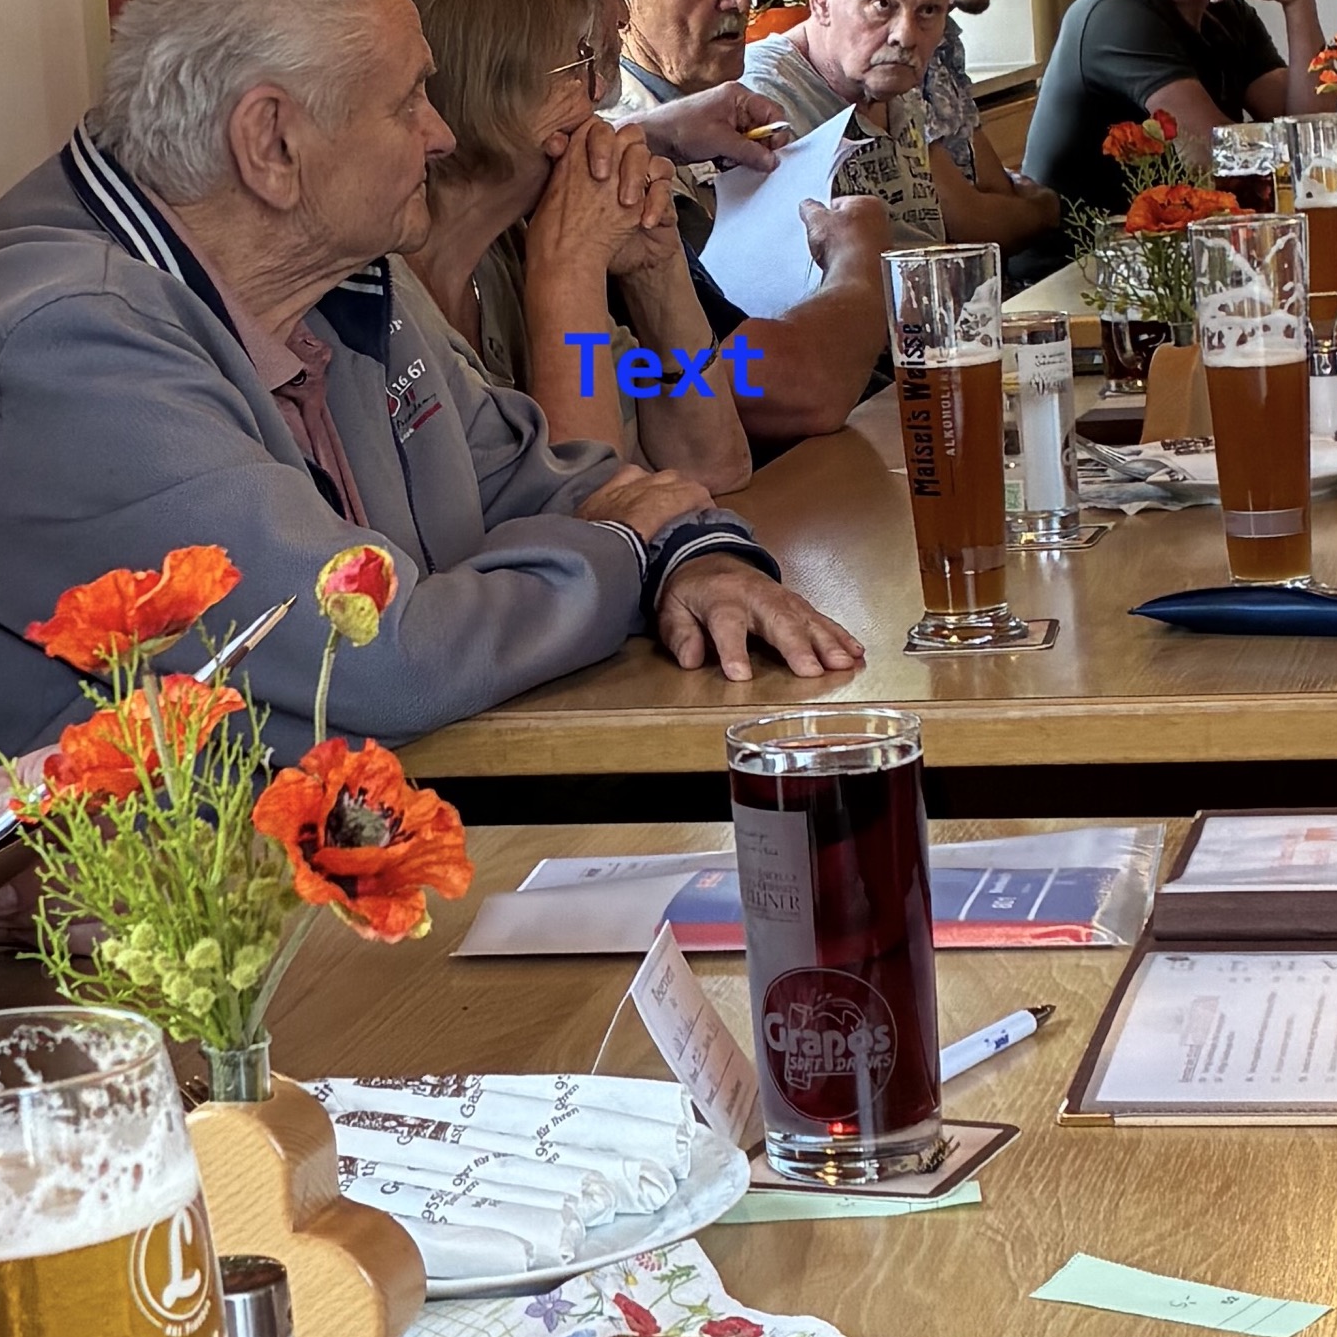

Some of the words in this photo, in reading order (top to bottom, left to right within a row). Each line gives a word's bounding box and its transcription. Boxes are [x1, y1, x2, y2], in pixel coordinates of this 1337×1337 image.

[408, 358, 427, 379] 67
[901, 324, 932, 401] Weisse
[906, 410, 941, 497] Maisel's
[789, 1055, 824, 1071] SOFT
[161, 1208, 201, 1310] L
